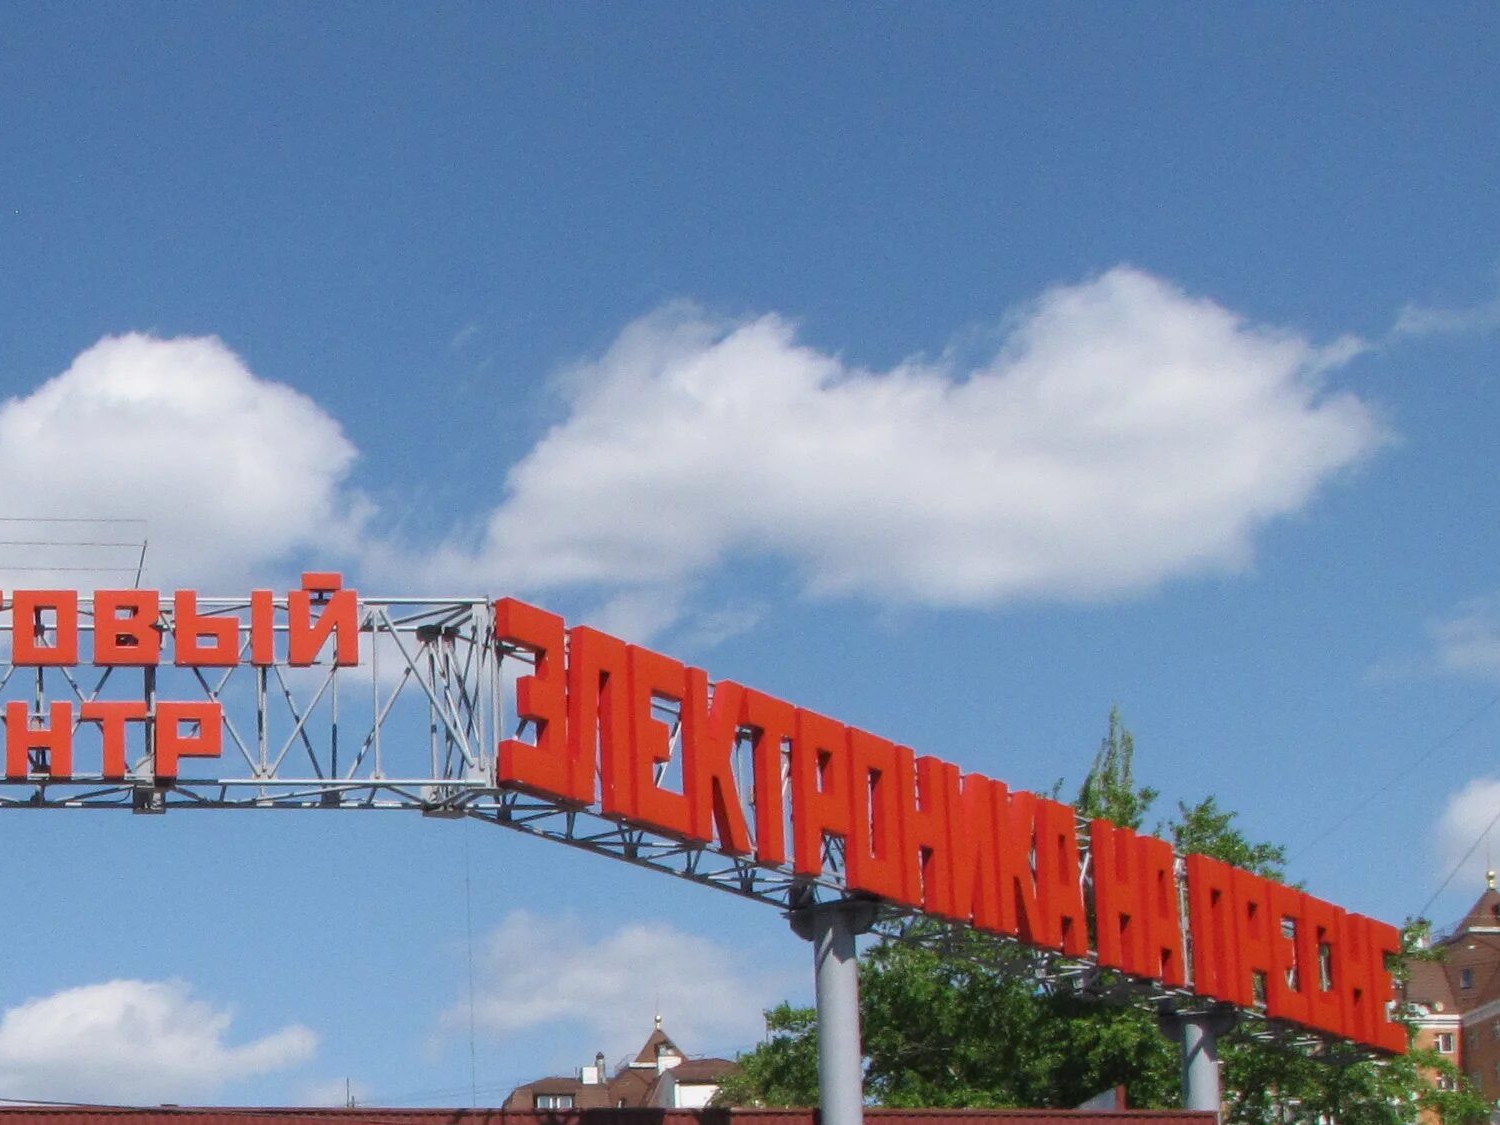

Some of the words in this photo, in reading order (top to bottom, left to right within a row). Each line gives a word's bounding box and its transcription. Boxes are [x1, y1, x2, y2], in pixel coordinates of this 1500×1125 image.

[497, 597, 1088, 957] ЭЛЕКТРОНИКА
[1089, 818, 1184, 986] НА
[1187, 852, 1407, 1055] ПРЕСНЕ
